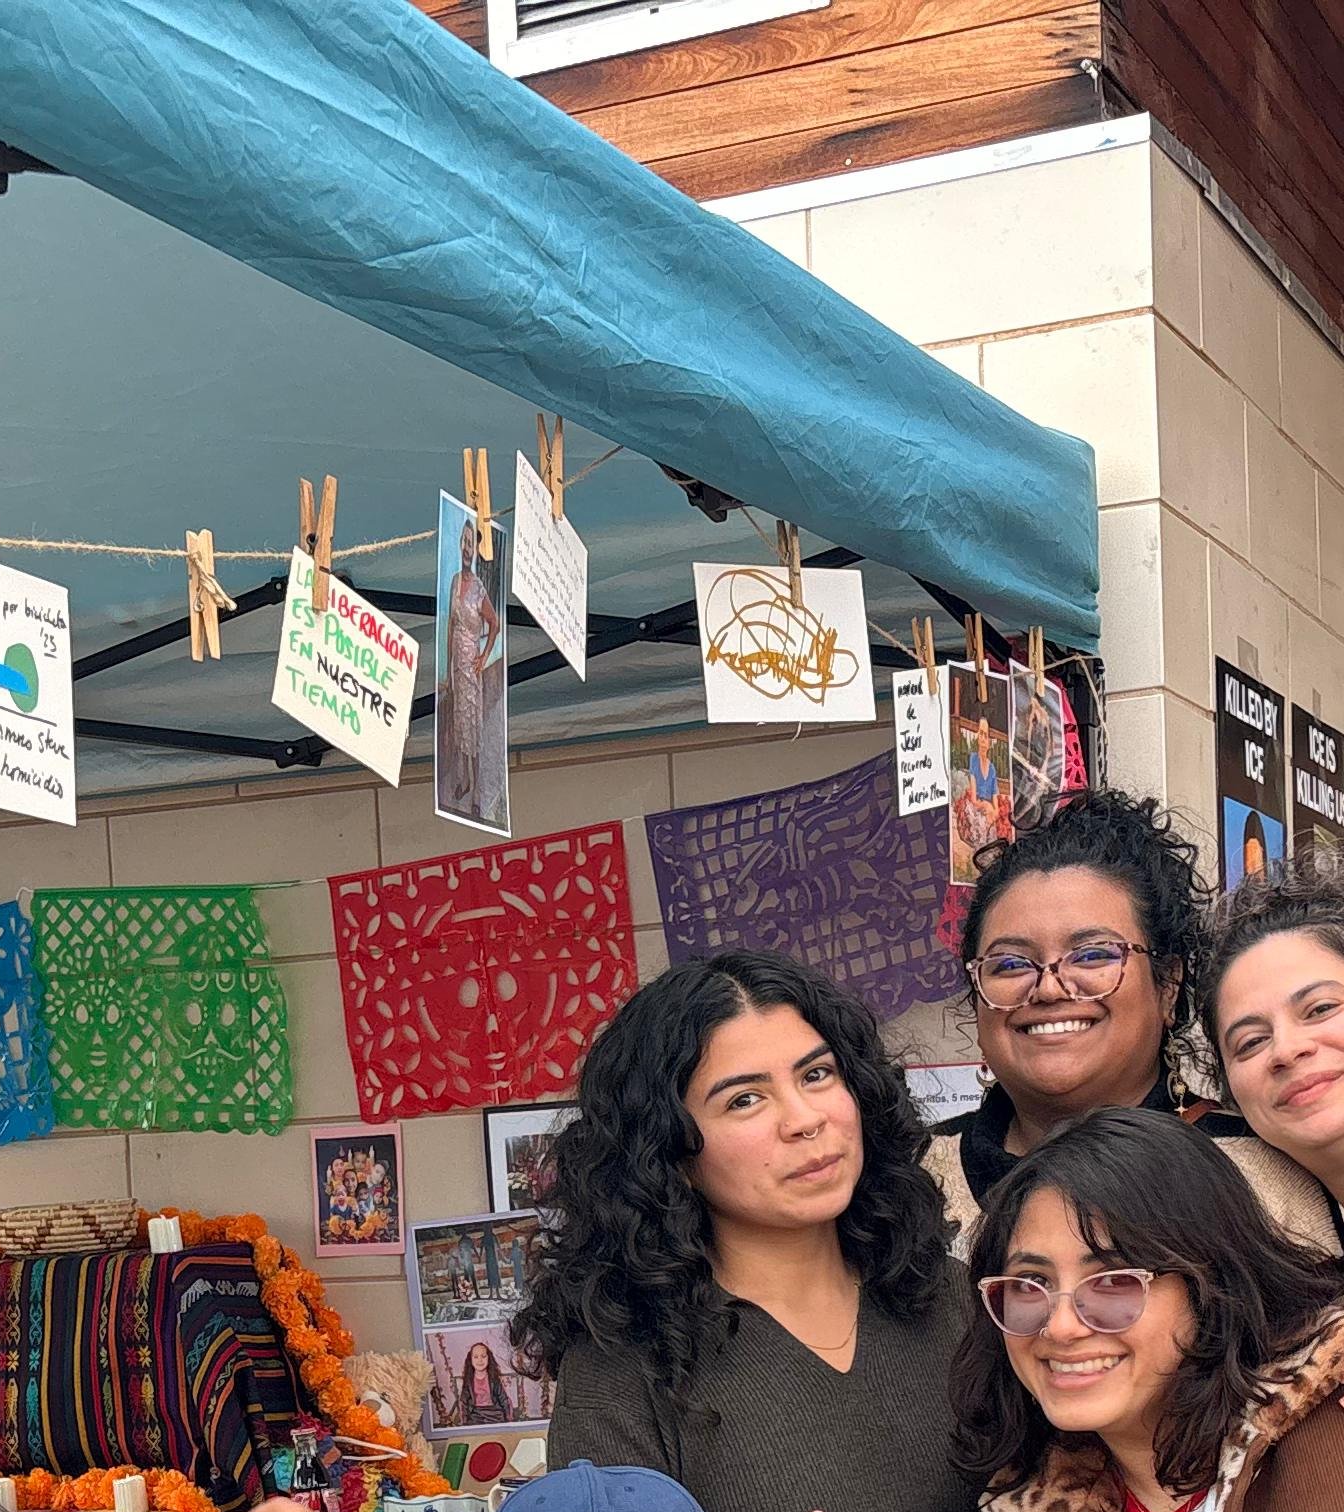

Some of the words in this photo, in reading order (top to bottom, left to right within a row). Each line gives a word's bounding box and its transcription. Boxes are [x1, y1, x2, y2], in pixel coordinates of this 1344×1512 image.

[289, 630, 313, 661] EN
[292, 598, 316, 629] ES
[324, 613, 399, 691] POSIBLE
[328, 587, 414, 673] IBERACIÓN
[284, 664, 361, 735] TIEMPO
[1224, 673, 1264, 731] KILLED
[1263, 698, 1278, 741] BY
[1244, 739, 1265, 785] ICE
[1307, 725, 1325, 768] ICE
[1325, 736, 1337, 774] IS
[1295, 767, 1335, 821] KILLING
